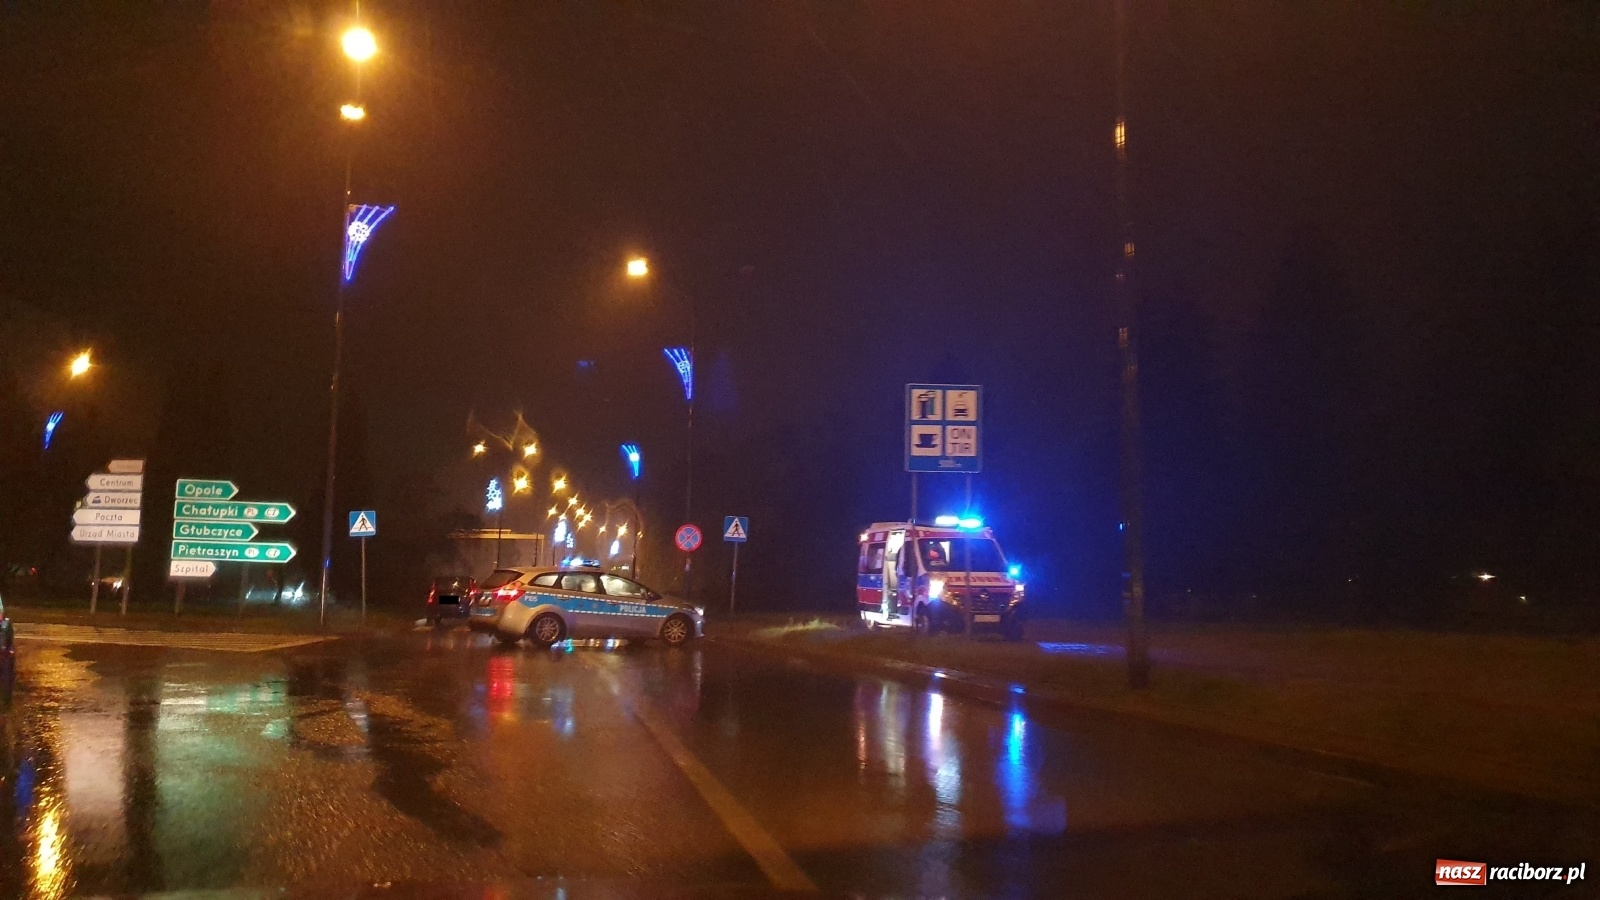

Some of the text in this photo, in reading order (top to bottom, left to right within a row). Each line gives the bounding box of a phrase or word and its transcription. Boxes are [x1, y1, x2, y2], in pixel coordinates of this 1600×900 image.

[100, 478, 134, 487] Centrum
[184, 484, 223, 496] Opole
[104, 495, 138, 504] Dworzec
[182, 504, 238, 517] Chałupki
[95, 513, 123, 521] Poczta
[106, 530, 135, 538] Miasta
[180, 525, 243, 538] Głubczyce
[178, 545, 239, 558] Pietraszyn
[175, 564, 209, 574] Szpital
[619, 605, 647, 614] POLICJA
